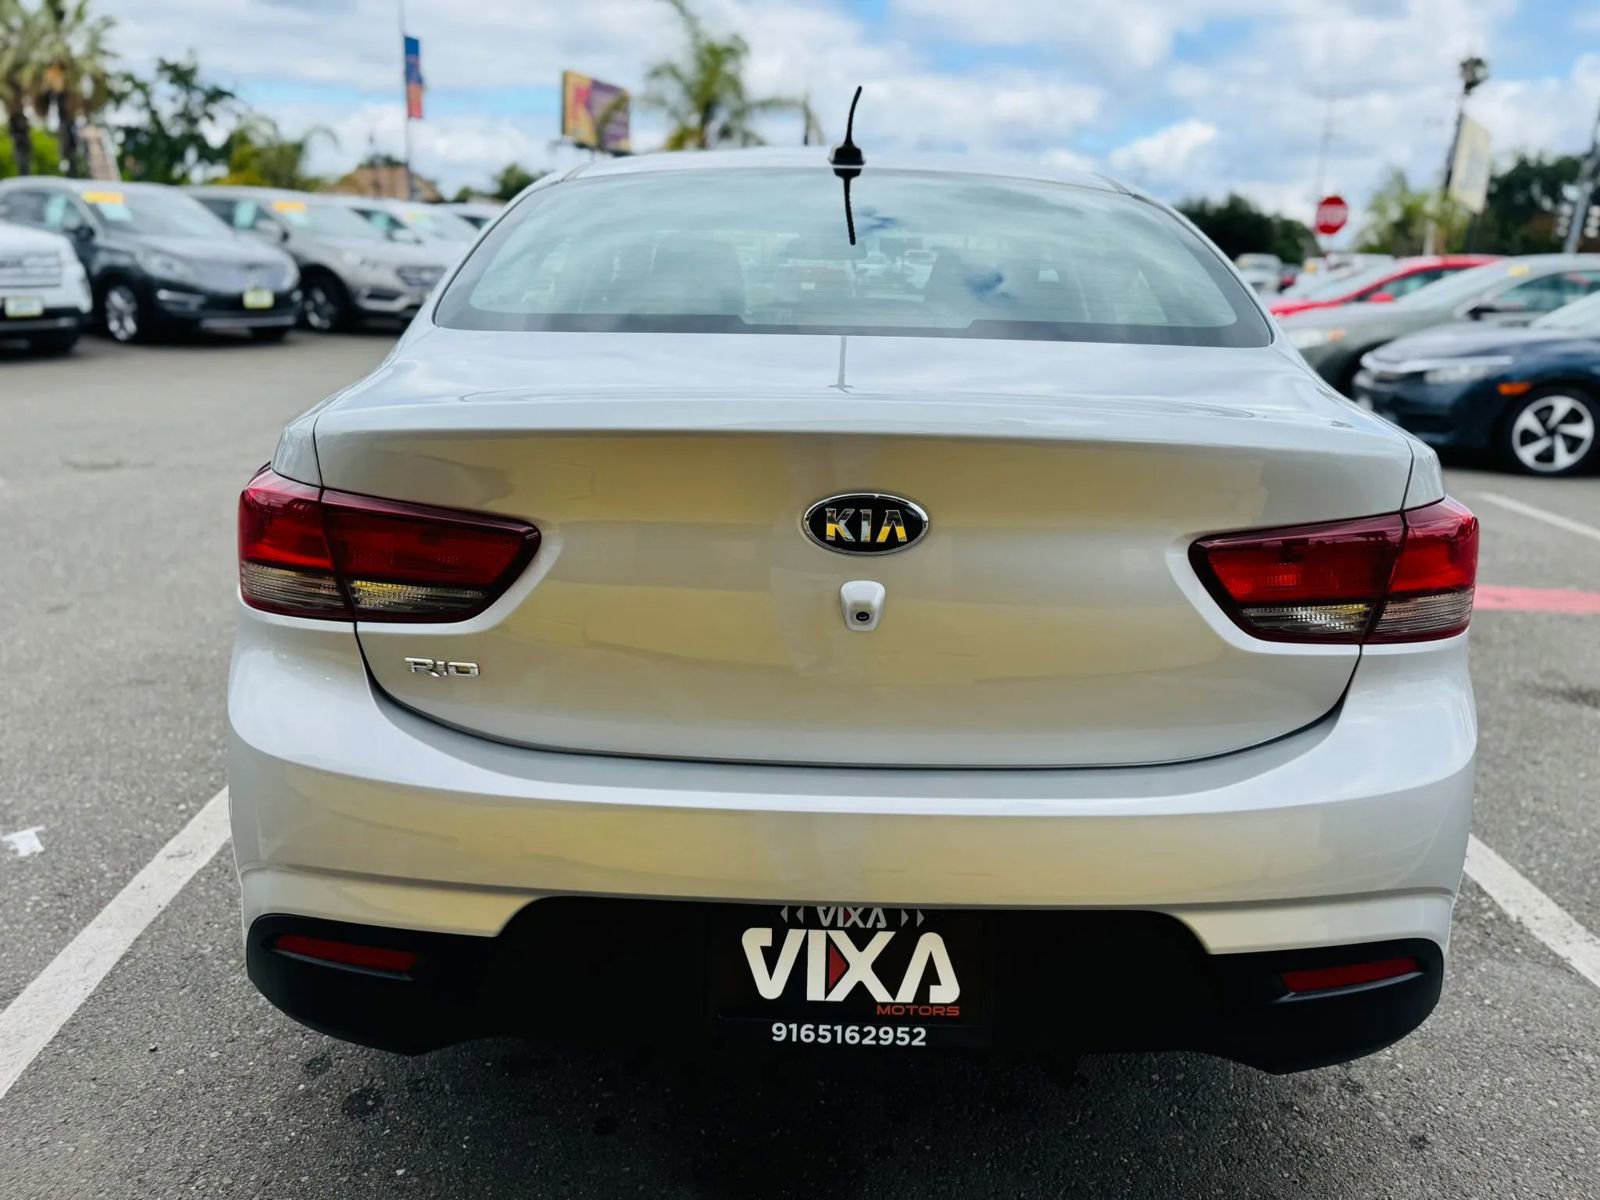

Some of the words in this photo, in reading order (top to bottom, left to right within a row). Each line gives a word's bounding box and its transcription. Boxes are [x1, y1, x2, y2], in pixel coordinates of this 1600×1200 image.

[826, 508, 908, 543] KIA
[405, 657, 480, 677] RIO
[816, 906, 887, 928] VIXA
[741, 927, 960, 1004] VIXA
[876, 1005, 960, 1016] MOTORS
[771, 1022, 927, 1046] 9165162952
